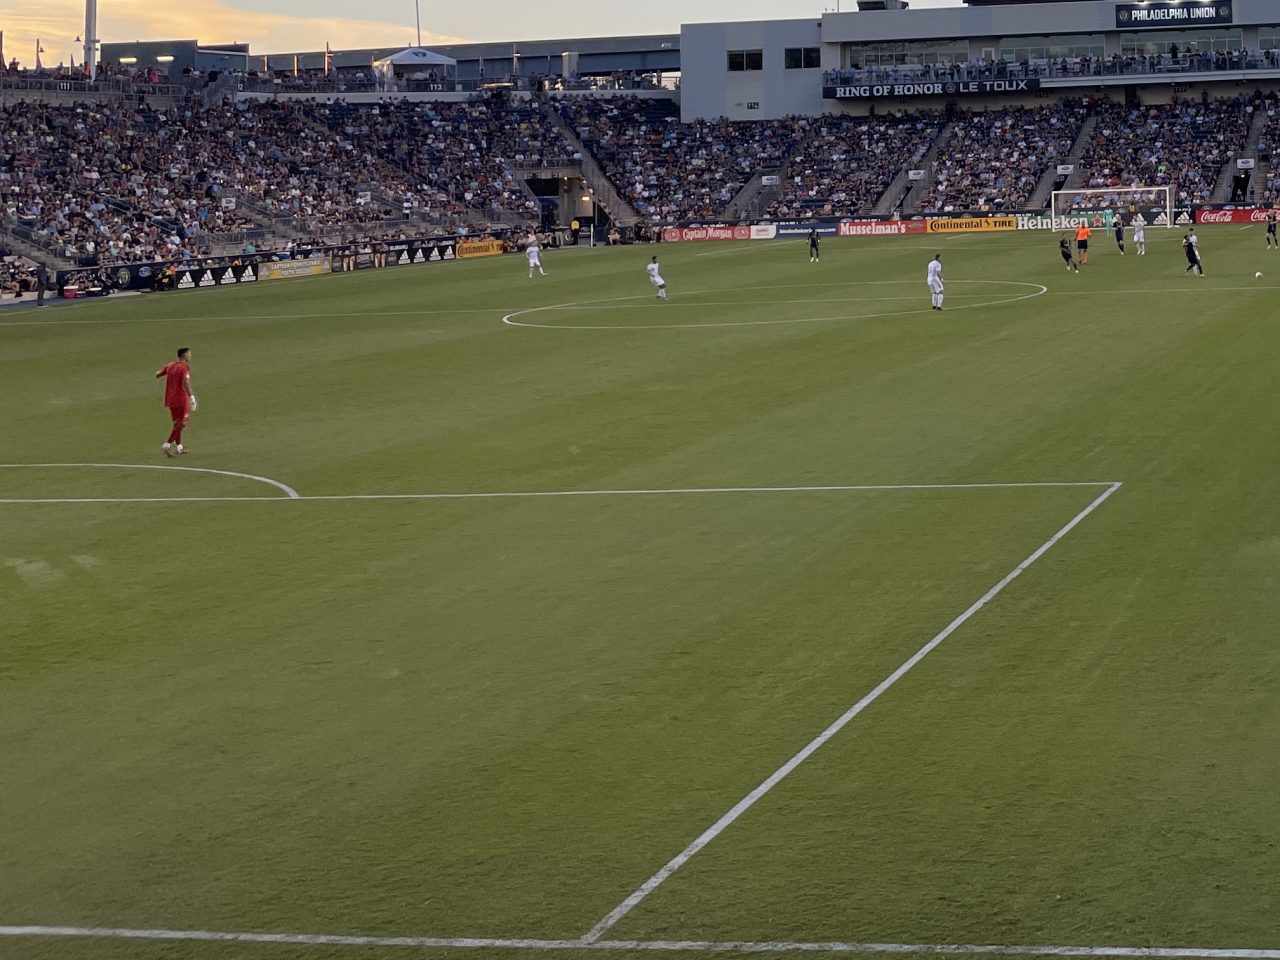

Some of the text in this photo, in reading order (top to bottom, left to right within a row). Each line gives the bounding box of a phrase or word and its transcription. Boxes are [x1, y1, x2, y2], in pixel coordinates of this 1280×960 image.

[1131, 6, 1216, 21] PHILADELPHIA UNION
[835, 80, 1028, 98] RING OF HONOR LE TOUX
[840, 222, 906, 235] Musselman's
[930, 219, 982, 231] Continental
[1017, 215, 1089, 230] Heineken
[683, 227, 733, 240] Captain Morgan
